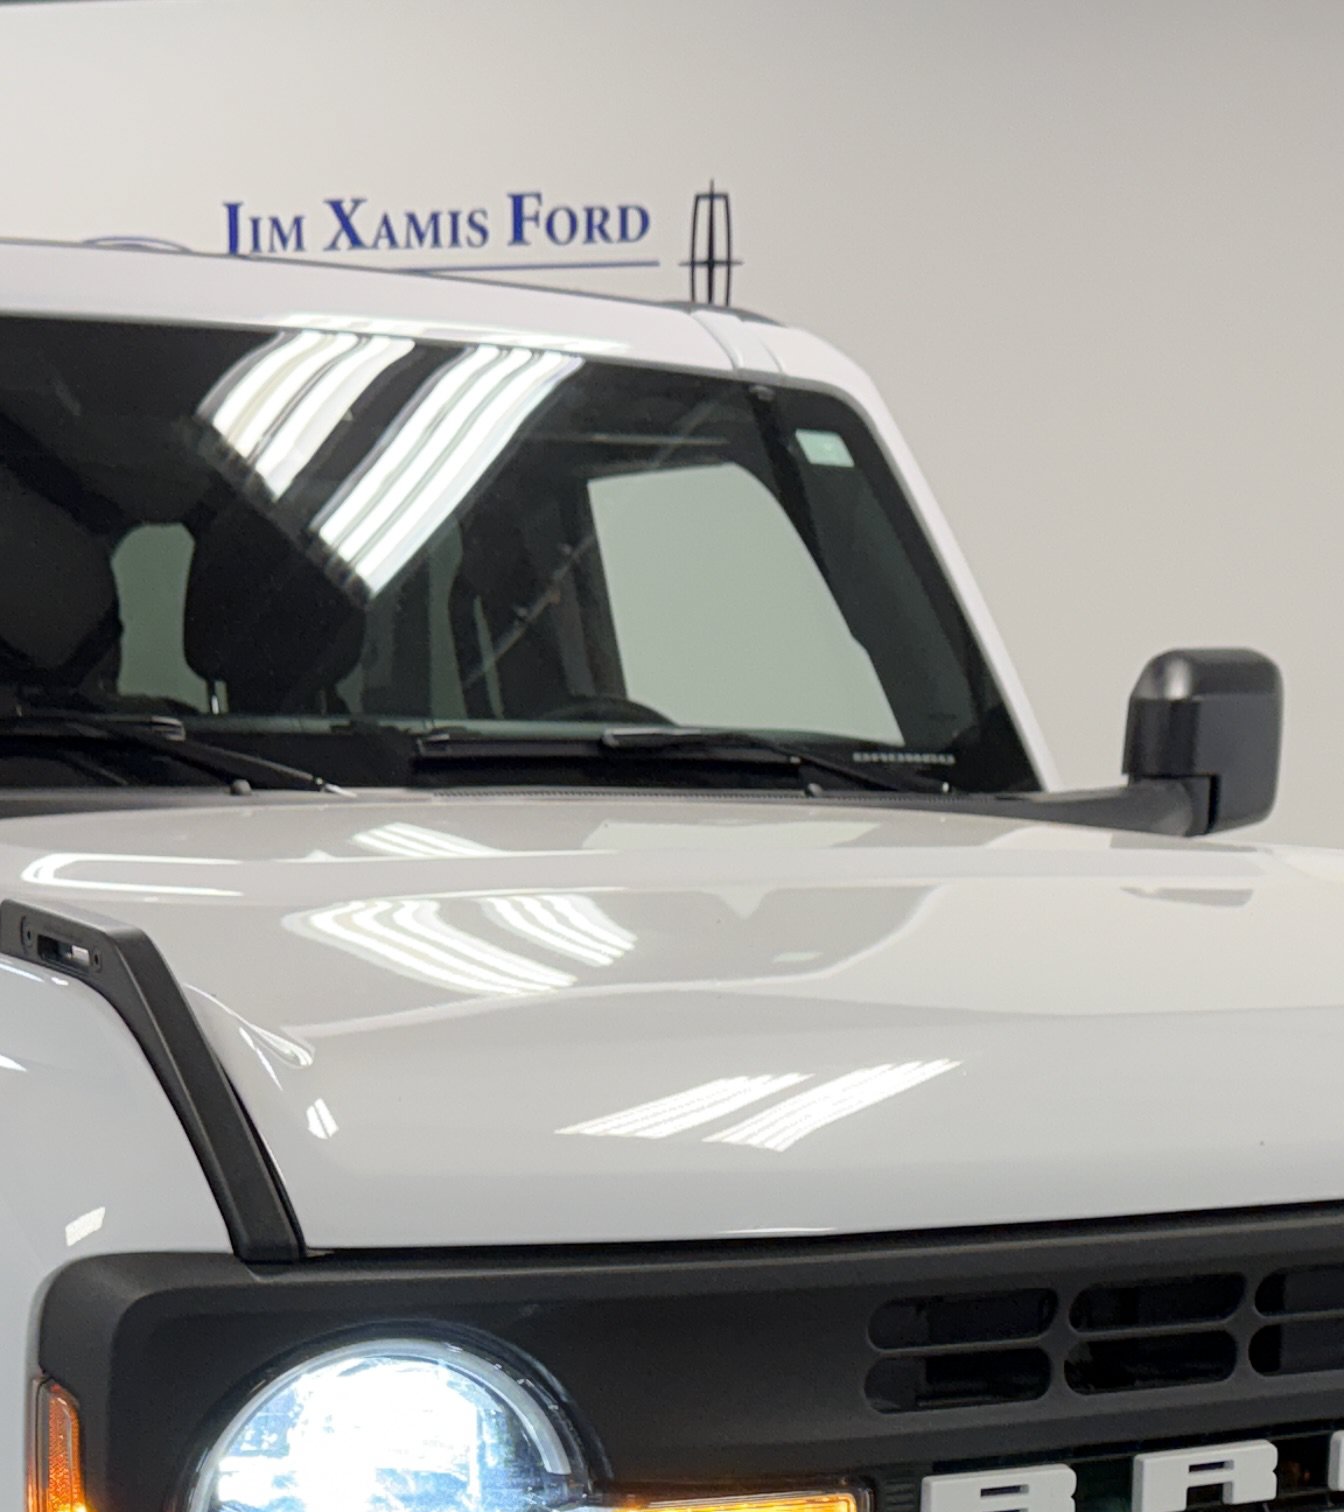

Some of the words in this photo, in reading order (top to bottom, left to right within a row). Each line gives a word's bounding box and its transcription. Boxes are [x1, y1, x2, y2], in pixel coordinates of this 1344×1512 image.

[222, 201, 306, 256] JIM
[322, 198, 490, 251] XAMIS
[506, 192, 651, 247] FORD
